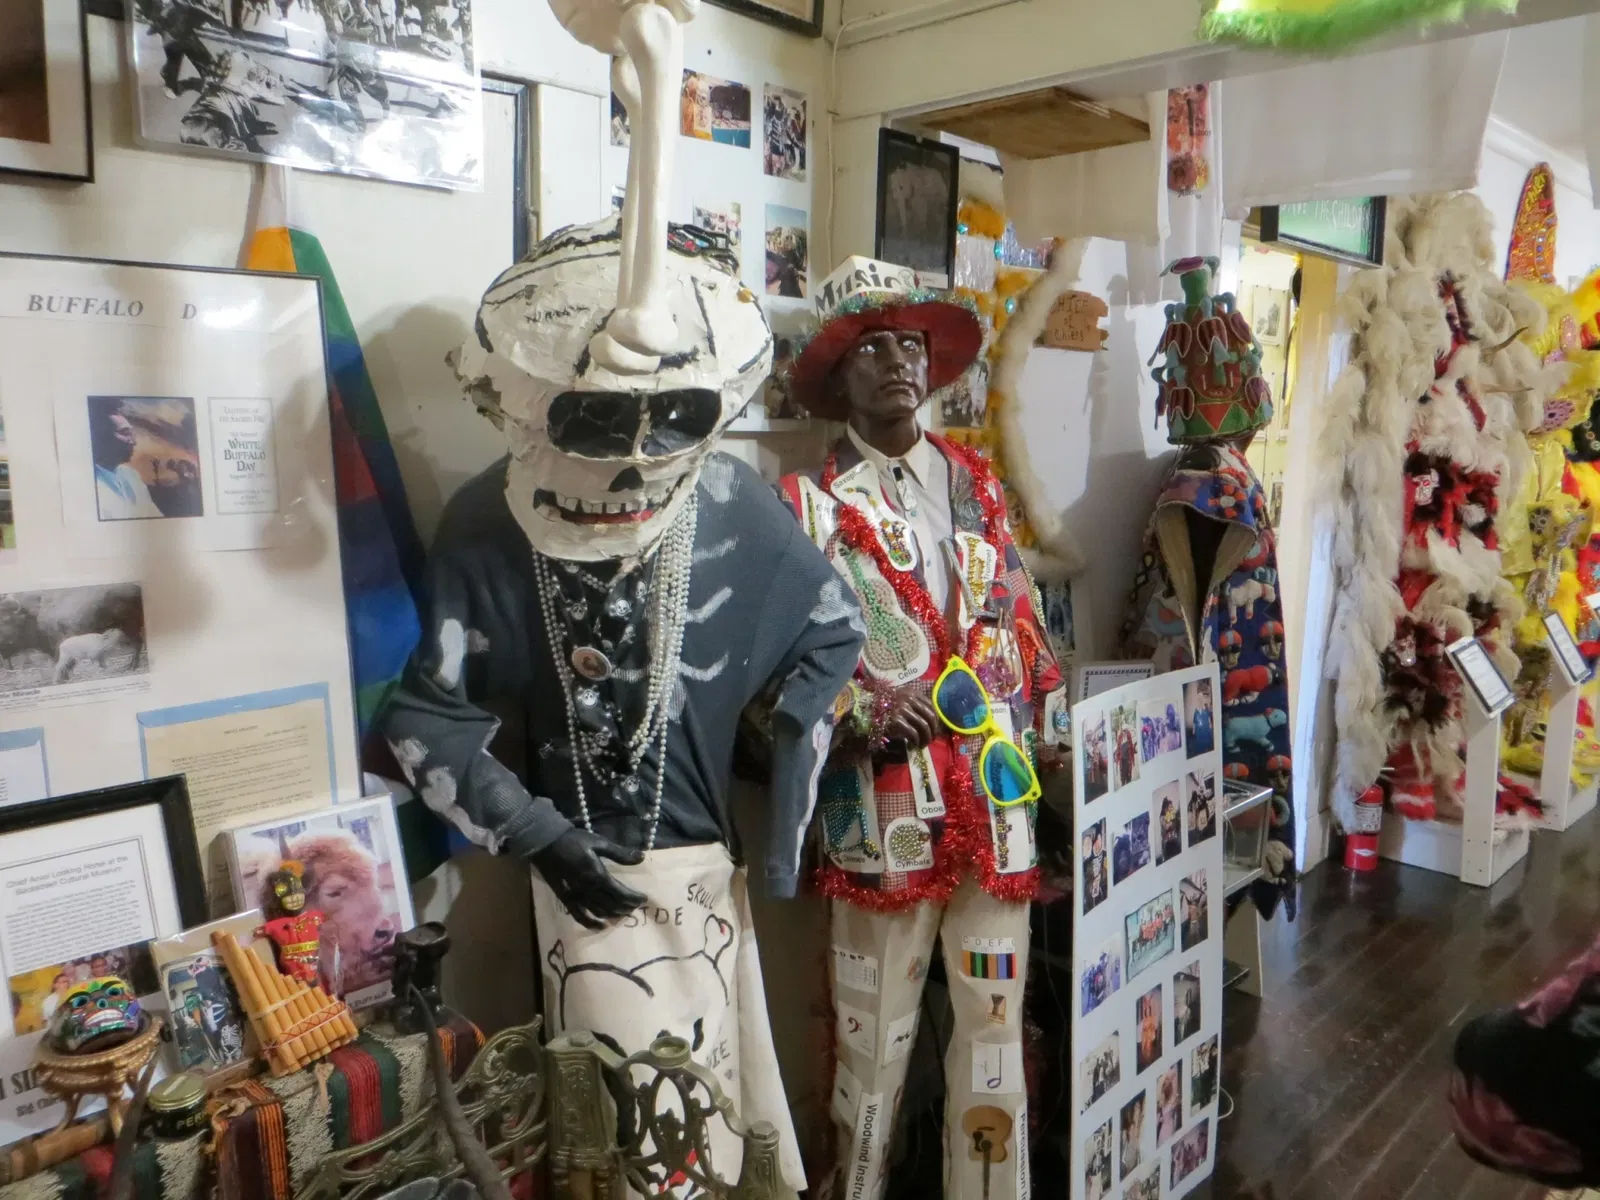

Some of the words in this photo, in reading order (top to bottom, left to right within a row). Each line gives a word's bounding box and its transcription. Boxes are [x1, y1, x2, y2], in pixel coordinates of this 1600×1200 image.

[815, 263, 902, 318] Music
[27, 293, 144, 317] BUFFALO
[228, 438, 261, 449] WHITE
[224, 449, 266, 460] BUFFALO
[237, 461, 256, 472] DAY
[984, 549, 997, 582] Trumpet
[897, 666, 919, 681] Cello
[921, 805, 944, 815] Oboe
[51, 866, 82, 879] Looking
[90, 866, 123, 878] Museum
[895, 858, 931, 869] Cymbals
[686, 883, 716, 911] SKULL
[623, 906, 684, 928] SIDE
[858, 1103, 878, 1163] Woodwind
[1019, 1113, 1027, 1189] Percussion
[852, 1164, 868, 1200] Instru
